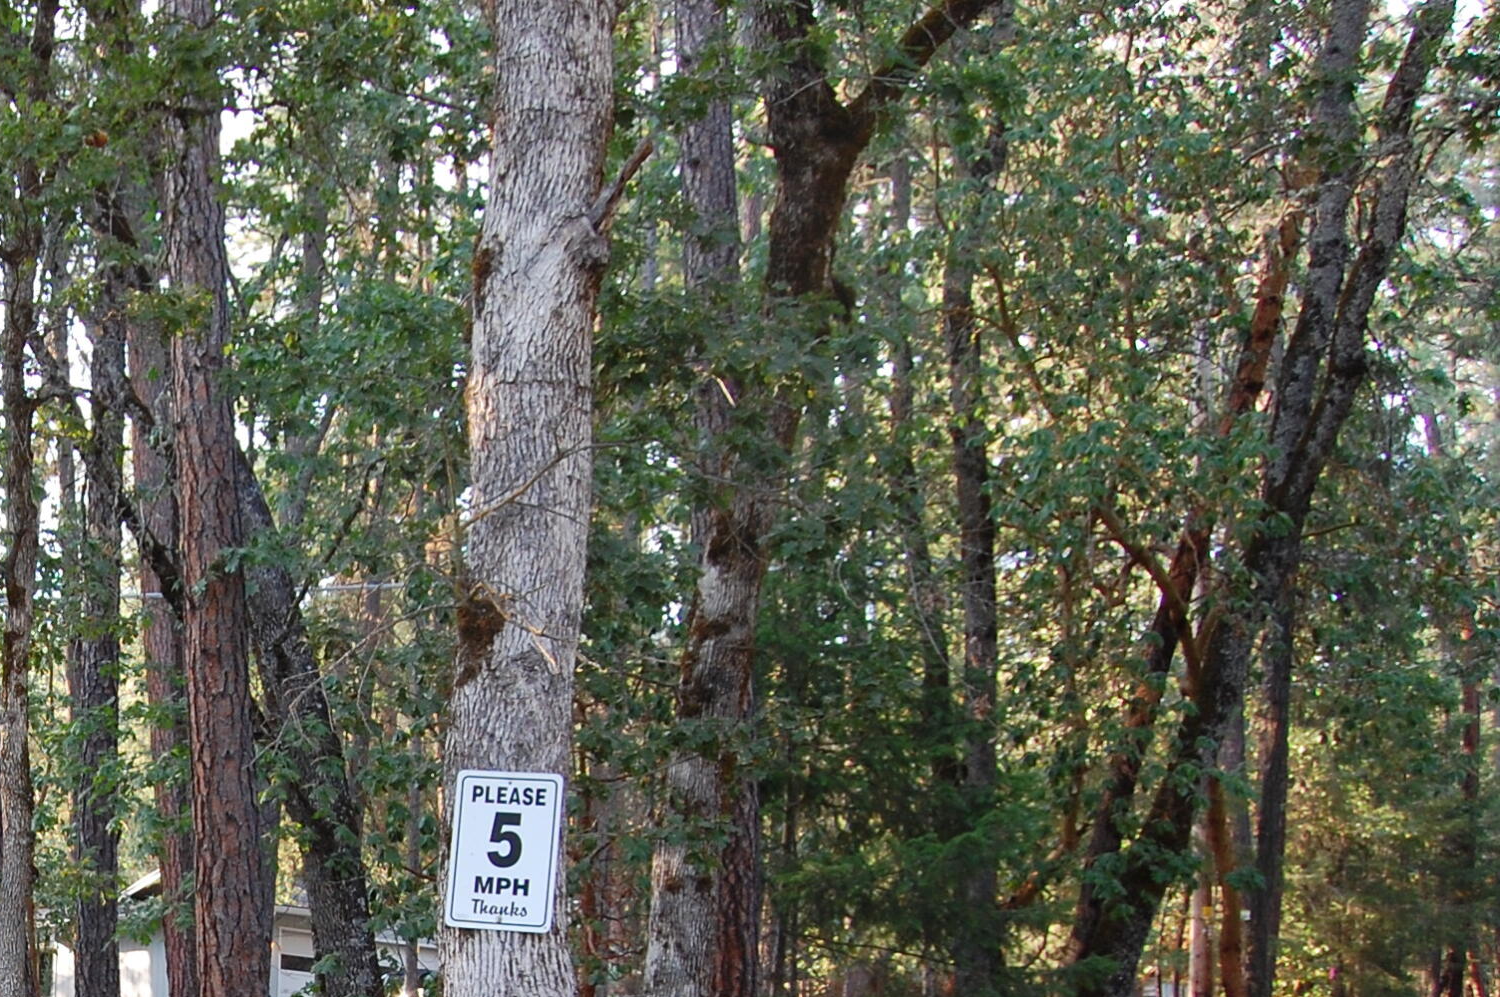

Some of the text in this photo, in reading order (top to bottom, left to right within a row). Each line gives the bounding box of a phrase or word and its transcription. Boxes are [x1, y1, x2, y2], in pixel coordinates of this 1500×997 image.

[472, 785, 547, 806] PLEASE
[487, 812, 523, 868] 5
[474, 876, 530, 896] MPH
[471, 898, 528, 917] Thanks
